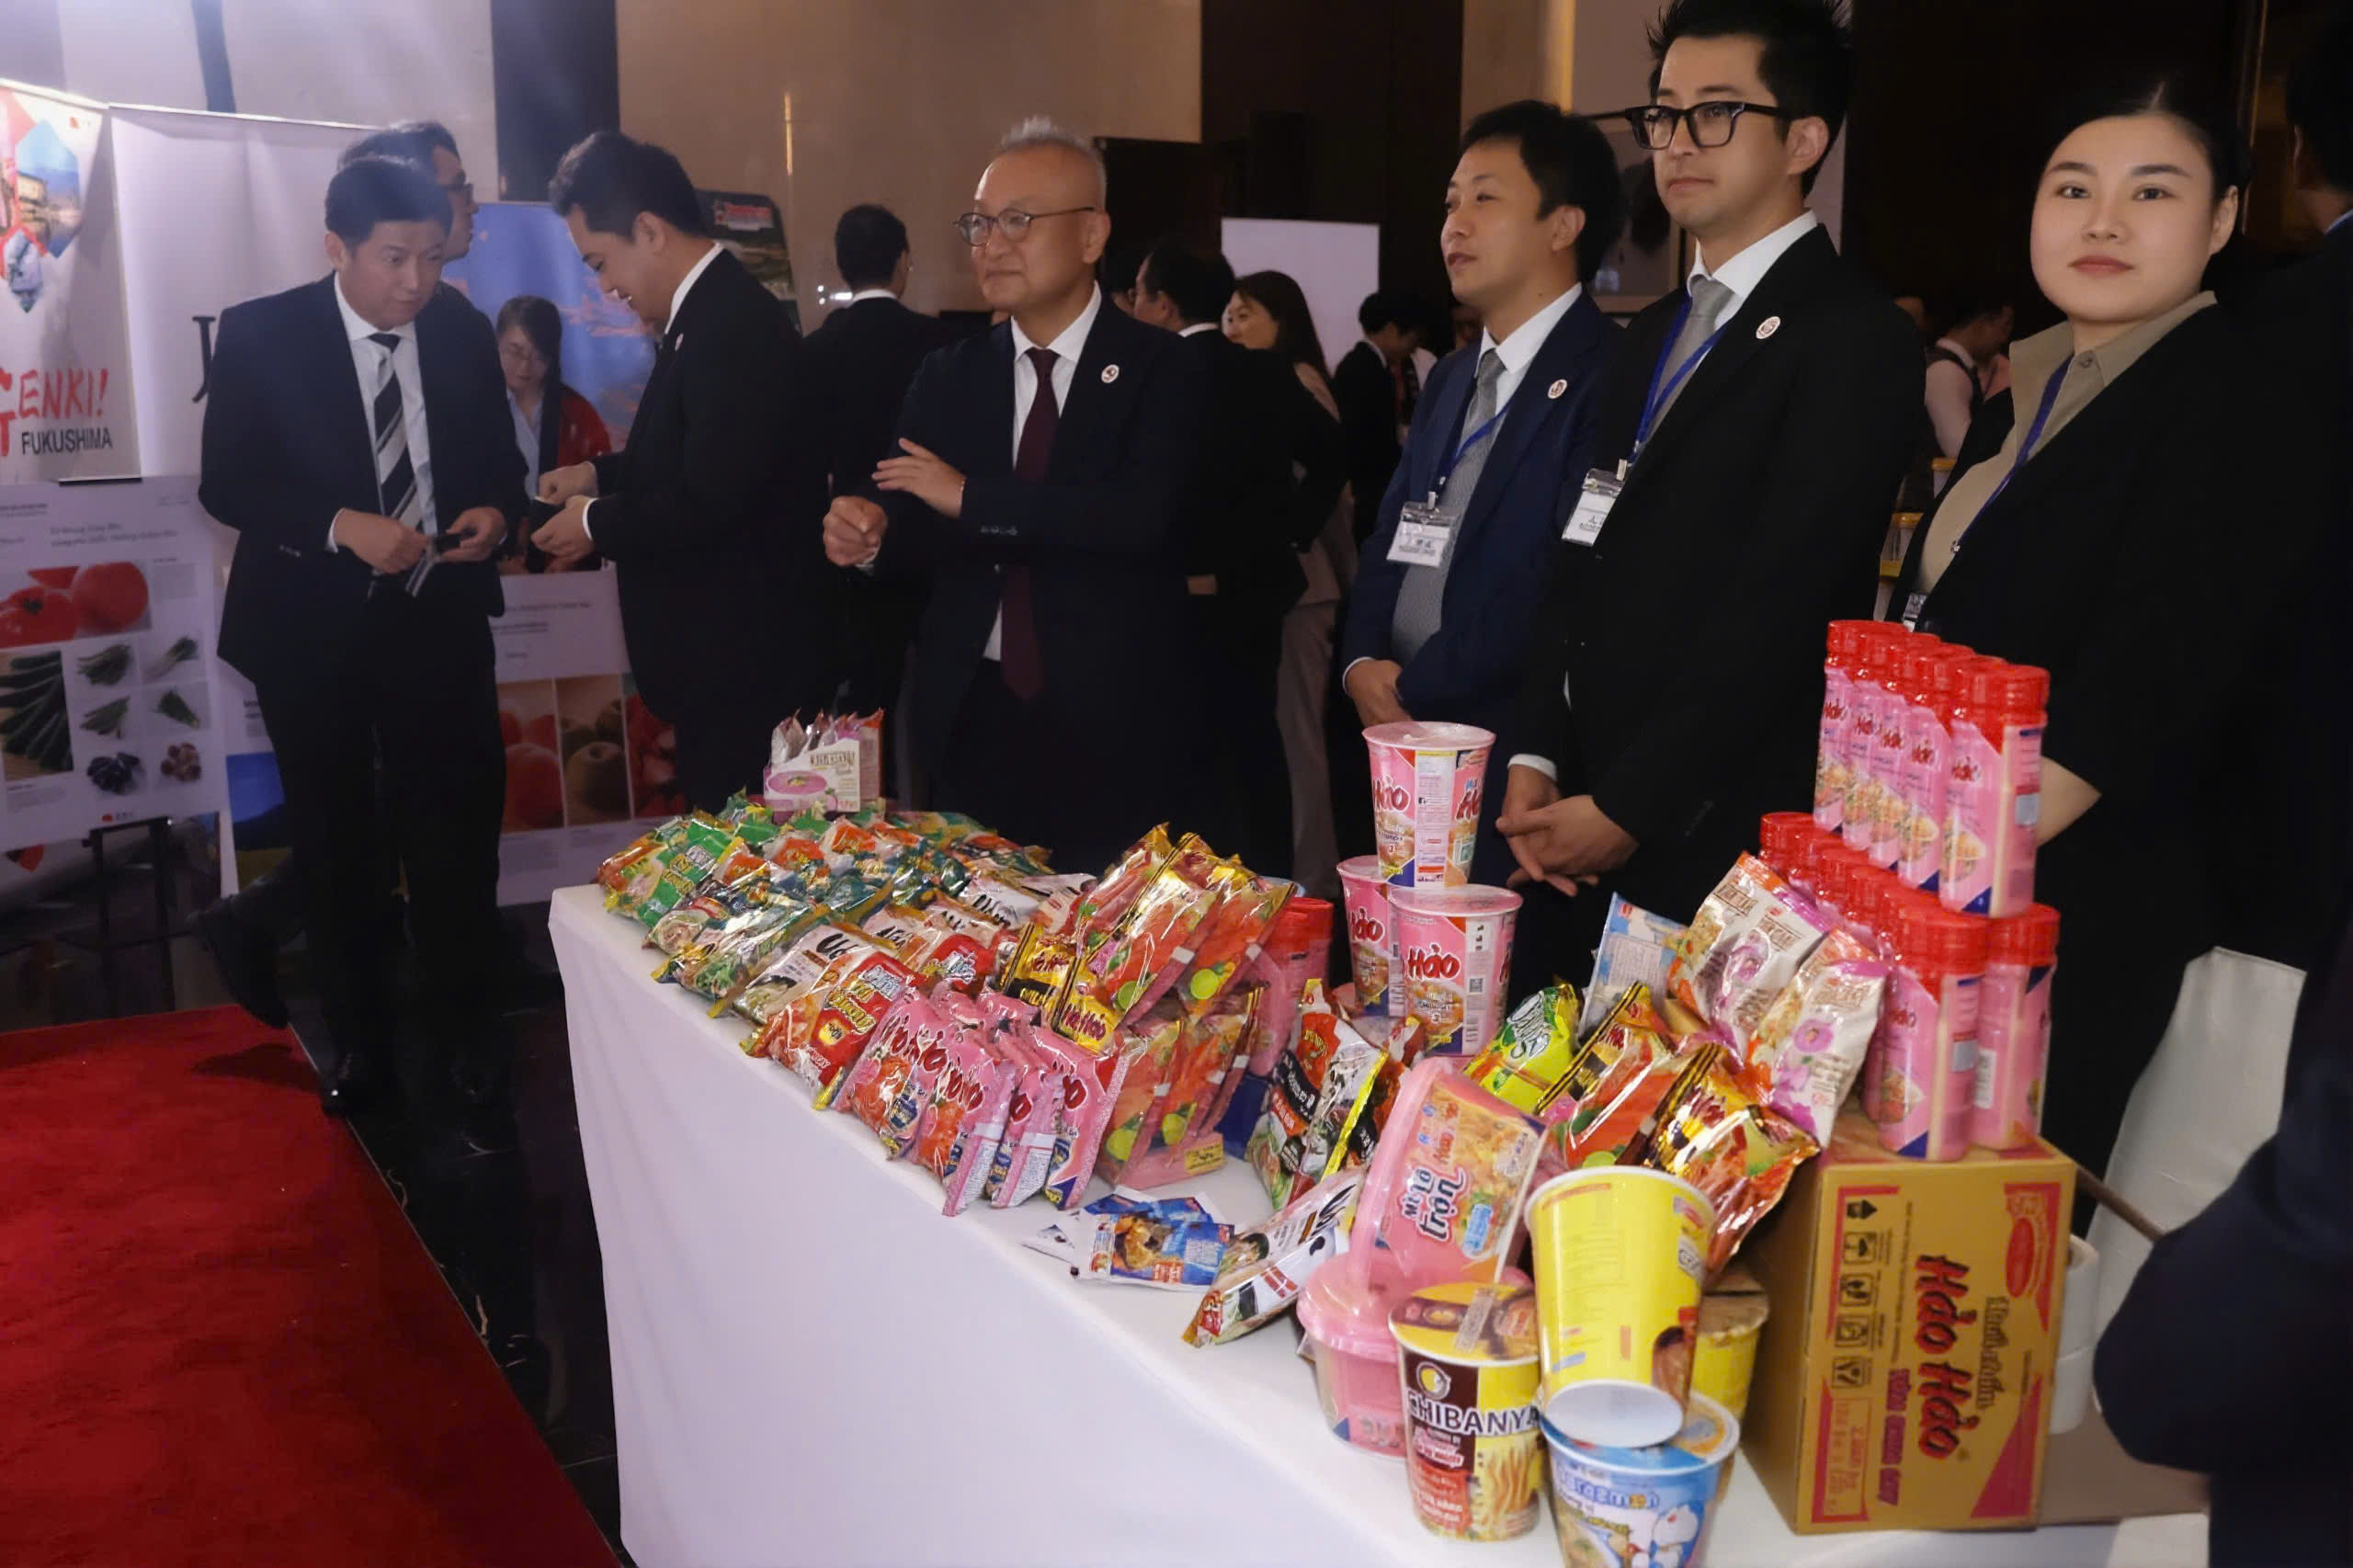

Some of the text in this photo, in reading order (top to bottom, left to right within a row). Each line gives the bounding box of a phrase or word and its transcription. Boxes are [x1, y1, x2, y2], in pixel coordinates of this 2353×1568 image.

[21, 426, 113, 456] FUKUSHIMA
[1407, 944, 1461, 981] Hảo
[1419, 1170, 1464, 1240] trộn
[1915, 1255, 1981, 1460] Hảo Hảo
